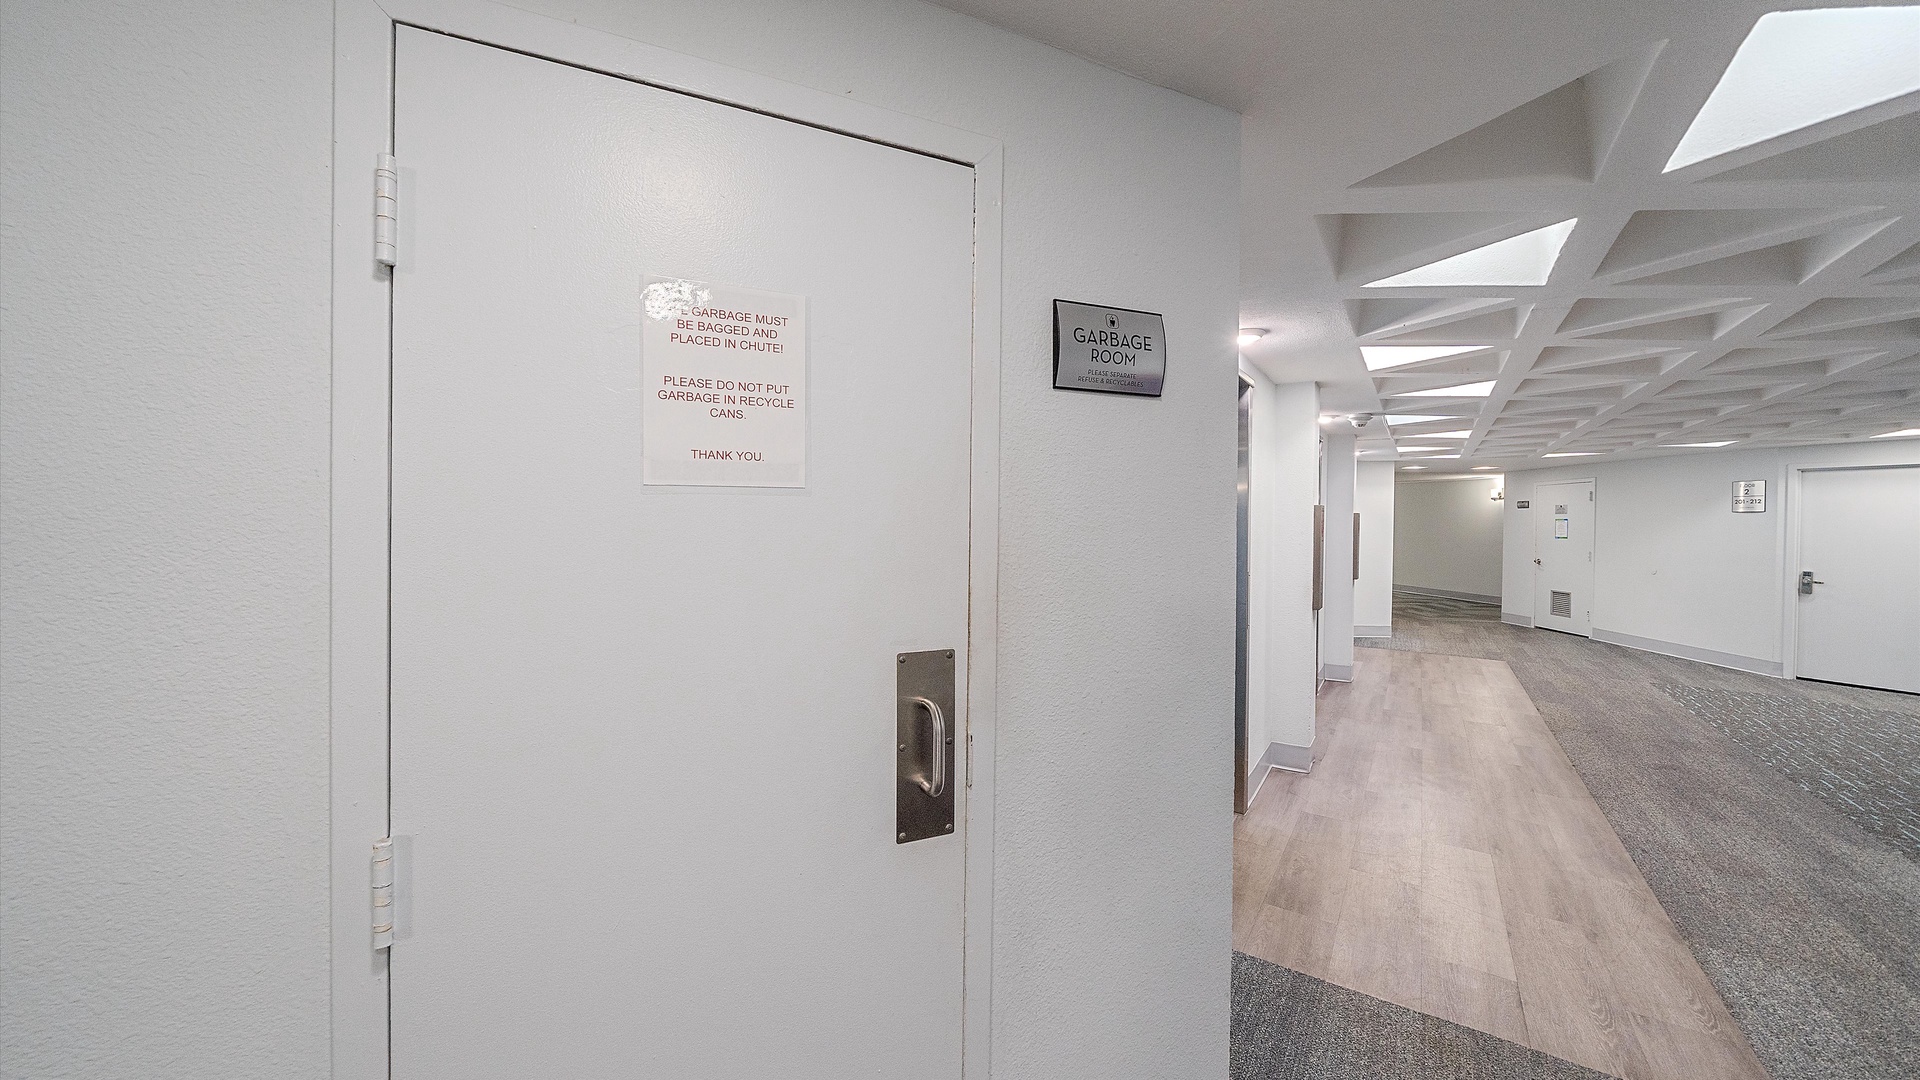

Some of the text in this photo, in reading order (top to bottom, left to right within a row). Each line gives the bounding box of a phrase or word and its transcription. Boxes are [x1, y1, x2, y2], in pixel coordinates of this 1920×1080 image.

[691, 307, 752, 323] GARBAGE
[755, 314, 789, 327] MUST
[677, 319, 778, 339] BE BAGGED AND
[670, 333, 784, 354] PLACED IN CHUTE!
[1073, 327, 1153, 352] GARBAGE
[1091, 348, 1136, 367] ROOM
[1077, 376, 1099, 384] REFUSE
[1106, 379, 1144, 388] RECYCLABLES
[1088, 369, 1137, 380] PLEASE SEPARATE
[664, 376, 790, 395] PLEASE DO NOT PUT
[657, 390, 795, 409] GARBAGE IN RECYCLE
[710, 408, 747, 420] CANS.
[691, 449, 765, 462] THANK YOU.
